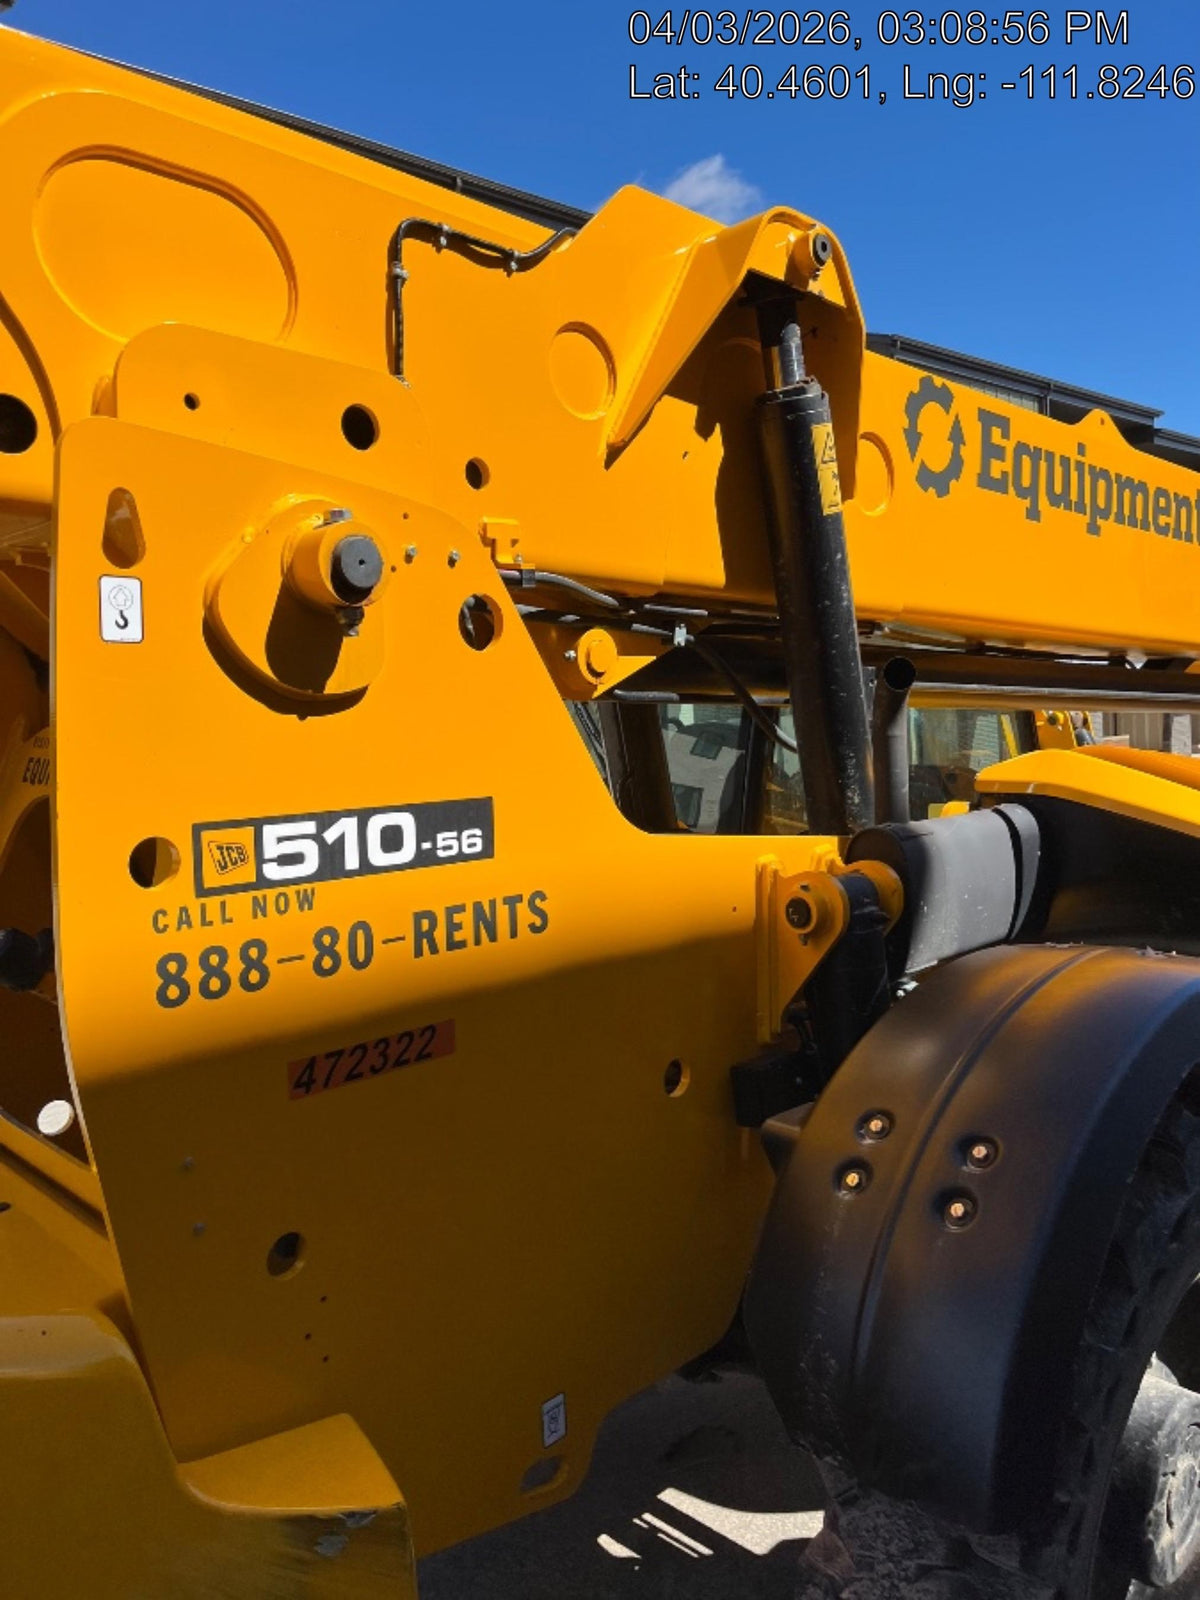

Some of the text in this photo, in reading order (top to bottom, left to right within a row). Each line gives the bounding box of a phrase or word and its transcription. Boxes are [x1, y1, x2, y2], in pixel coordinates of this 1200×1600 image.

[216, 843, 248, 872] JCB
[152, 887, 316, 934] CALL NOW
[155, 890, 549, 1008] 888-80-RENTS
[293, 1023, 438, 1095] 472322
